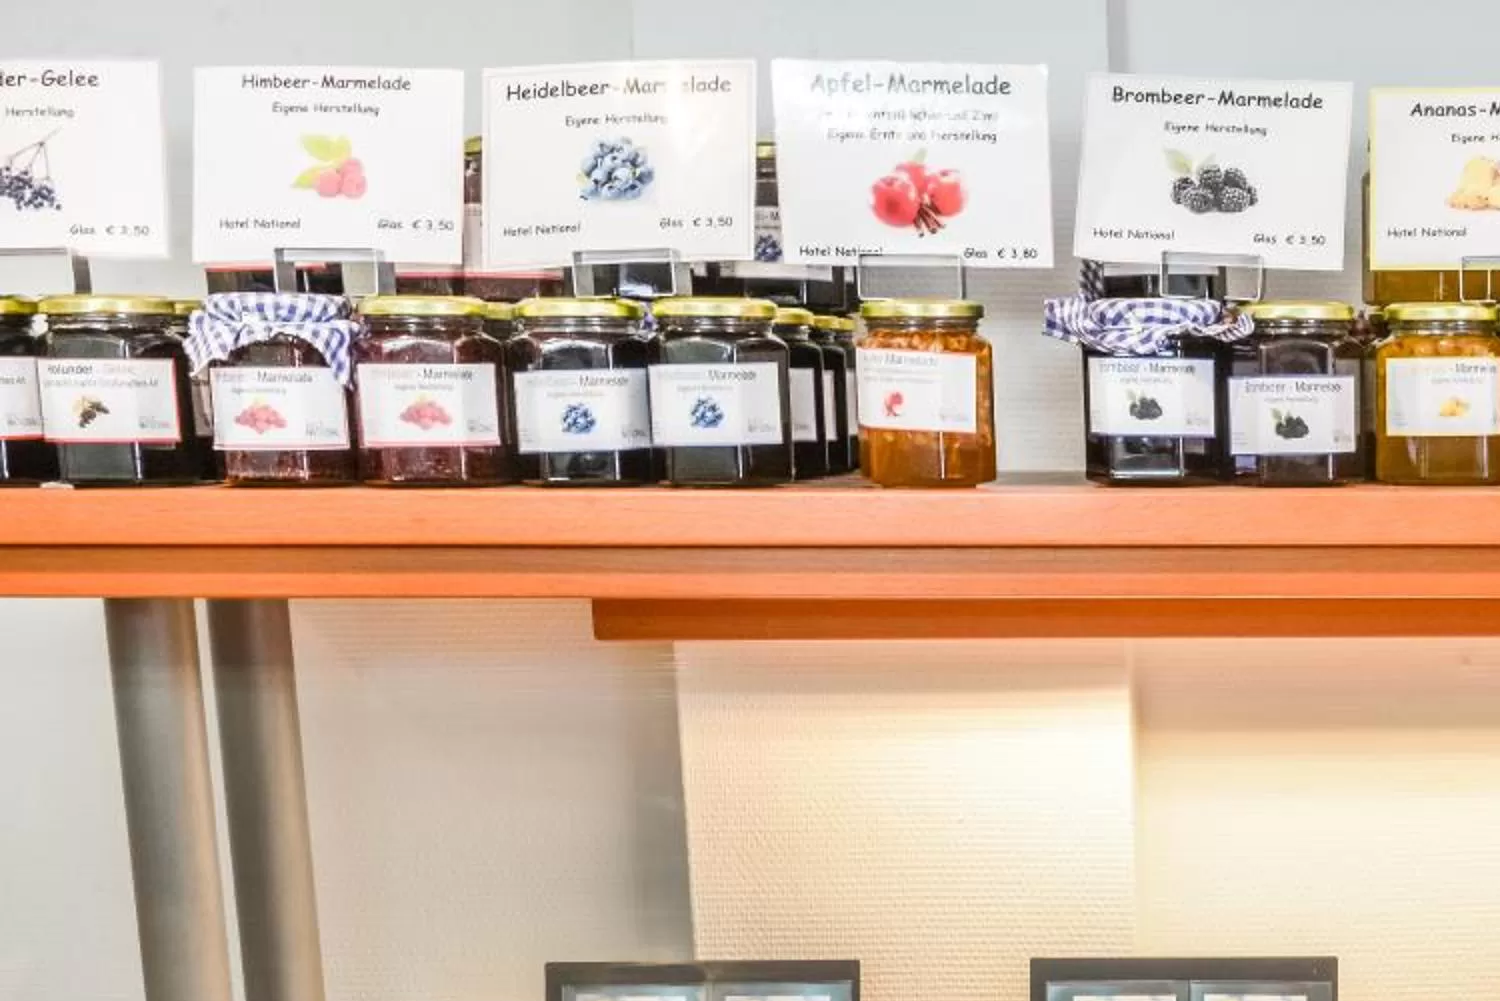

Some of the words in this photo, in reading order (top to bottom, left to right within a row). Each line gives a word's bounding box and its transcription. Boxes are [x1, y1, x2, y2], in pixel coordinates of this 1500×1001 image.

[241, 74, 412, 91] Himbeer-Marmelade
[506, 75, 732, 101] Heidelbeer-Marlade
[810, 72, 1012, 96] Apfel-Marmelade
[1112, 86, 1323, 109] Brombeer-Marmelade
[272, 102, 309, 116] Eigene
[313, 103, 380, 117] Herstellung
[565, 115, 600, 128] Eigene
[1164, 121, 1199, 134] Eigene
[1205, 122, 1268, 137] Herstellung
[1450, 133, 1485, 145] Eigene
[70, 224, 96, 236] Glas
[105, 225, 115, 236] €
[219, 218, 249, 230] Hotel
[254, 218, 301, 230] National
[378, 219, 403, 230] Glas
[412, 220, 421, 230] €
[503, 225, 532, 237] Hotel
[535, 223, 580, 236] National
[659, 217, 683, 228] Glas
[692, 217, 701, 228] €
[1093, 228, 1123, 239] Hotel
[1127, 229, 1175, 241] National
[1253, 233, 1276, 245] Glas
[1285, 234, 1295, 245] €
[1387, 227, 1417, 238] Hotel
[1421, 227, 1467, 238] National
[800, 246, 831, 257] Hotel
[997, 249, 1006, 259] €
